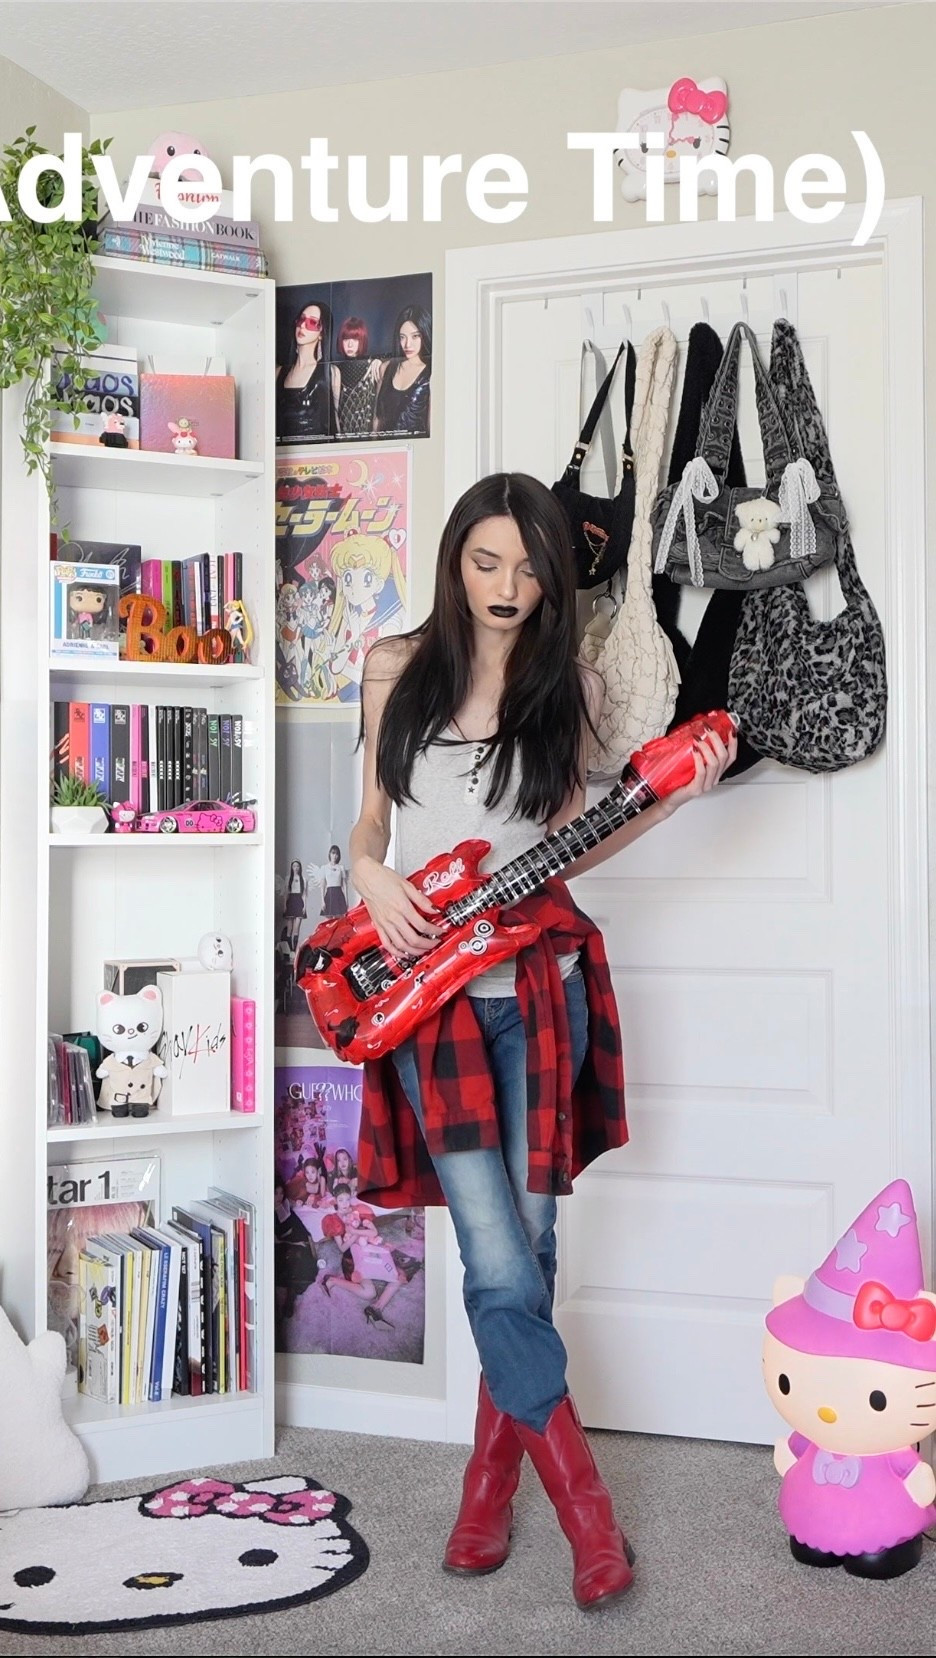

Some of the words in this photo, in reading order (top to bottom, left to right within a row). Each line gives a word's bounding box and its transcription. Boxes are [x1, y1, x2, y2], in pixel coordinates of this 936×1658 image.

[138, 243, 185, 261] Westwood
[211, 252, 242, 262] CATWALK
[118, 593, 232, 665] Boo
[98, 1170, 110, 1200] 1
